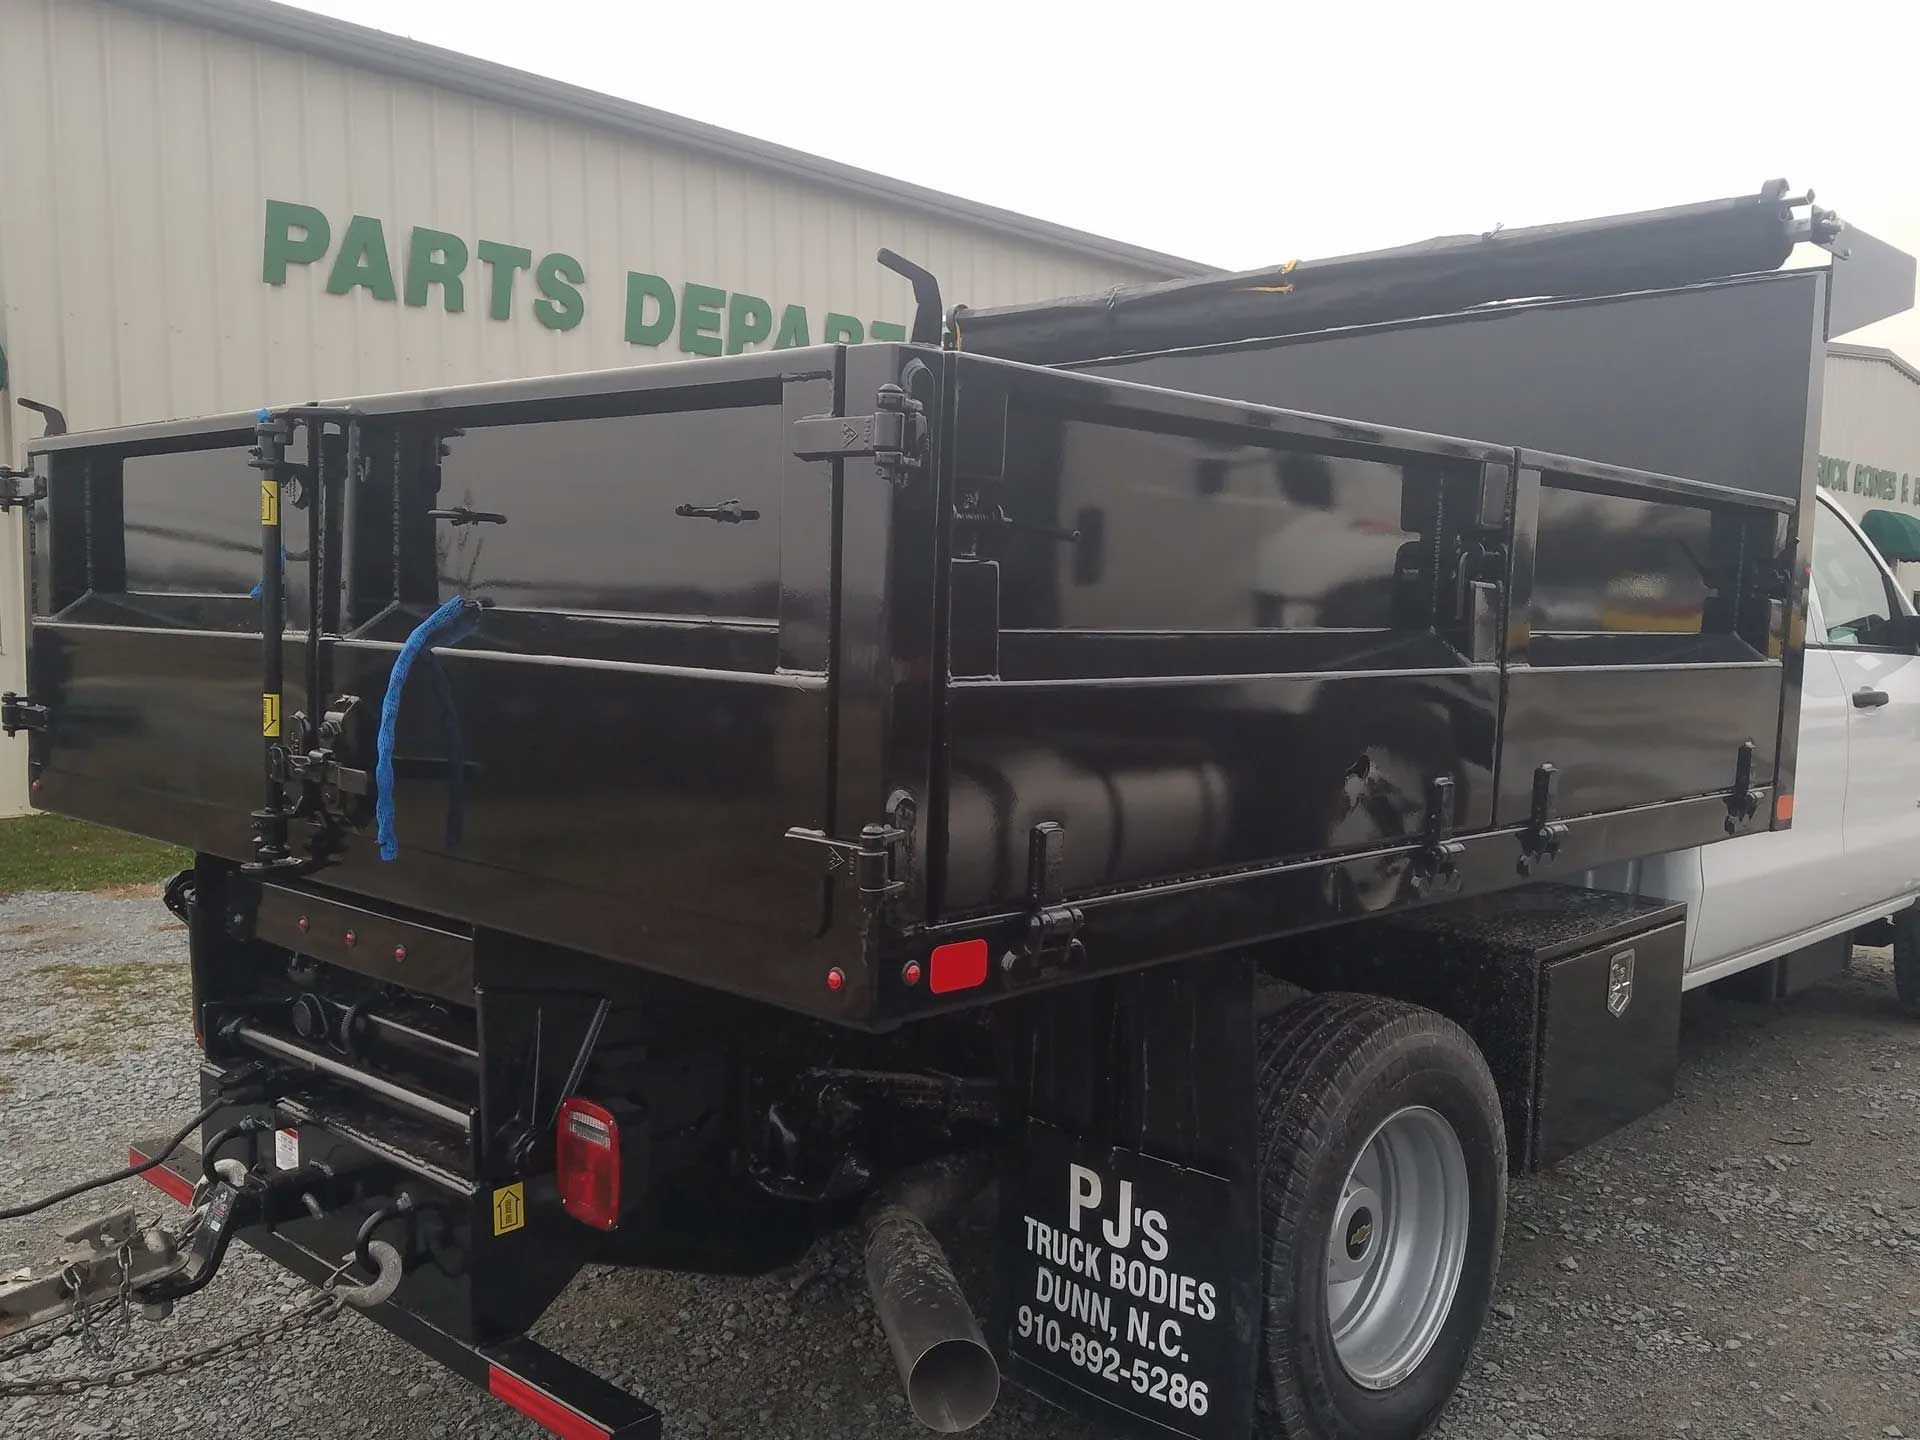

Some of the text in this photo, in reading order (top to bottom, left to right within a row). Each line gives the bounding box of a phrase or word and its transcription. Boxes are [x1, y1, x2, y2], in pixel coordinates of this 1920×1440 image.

[263, 200, 585, 332] PARTS
[1024, 1216, 1216, 1321] TRUCK BODIES
[1036, 1267, 1189, 1363] DUNN, N.C.
[1018, 1305, 1209, 1416] 910-892-5286
